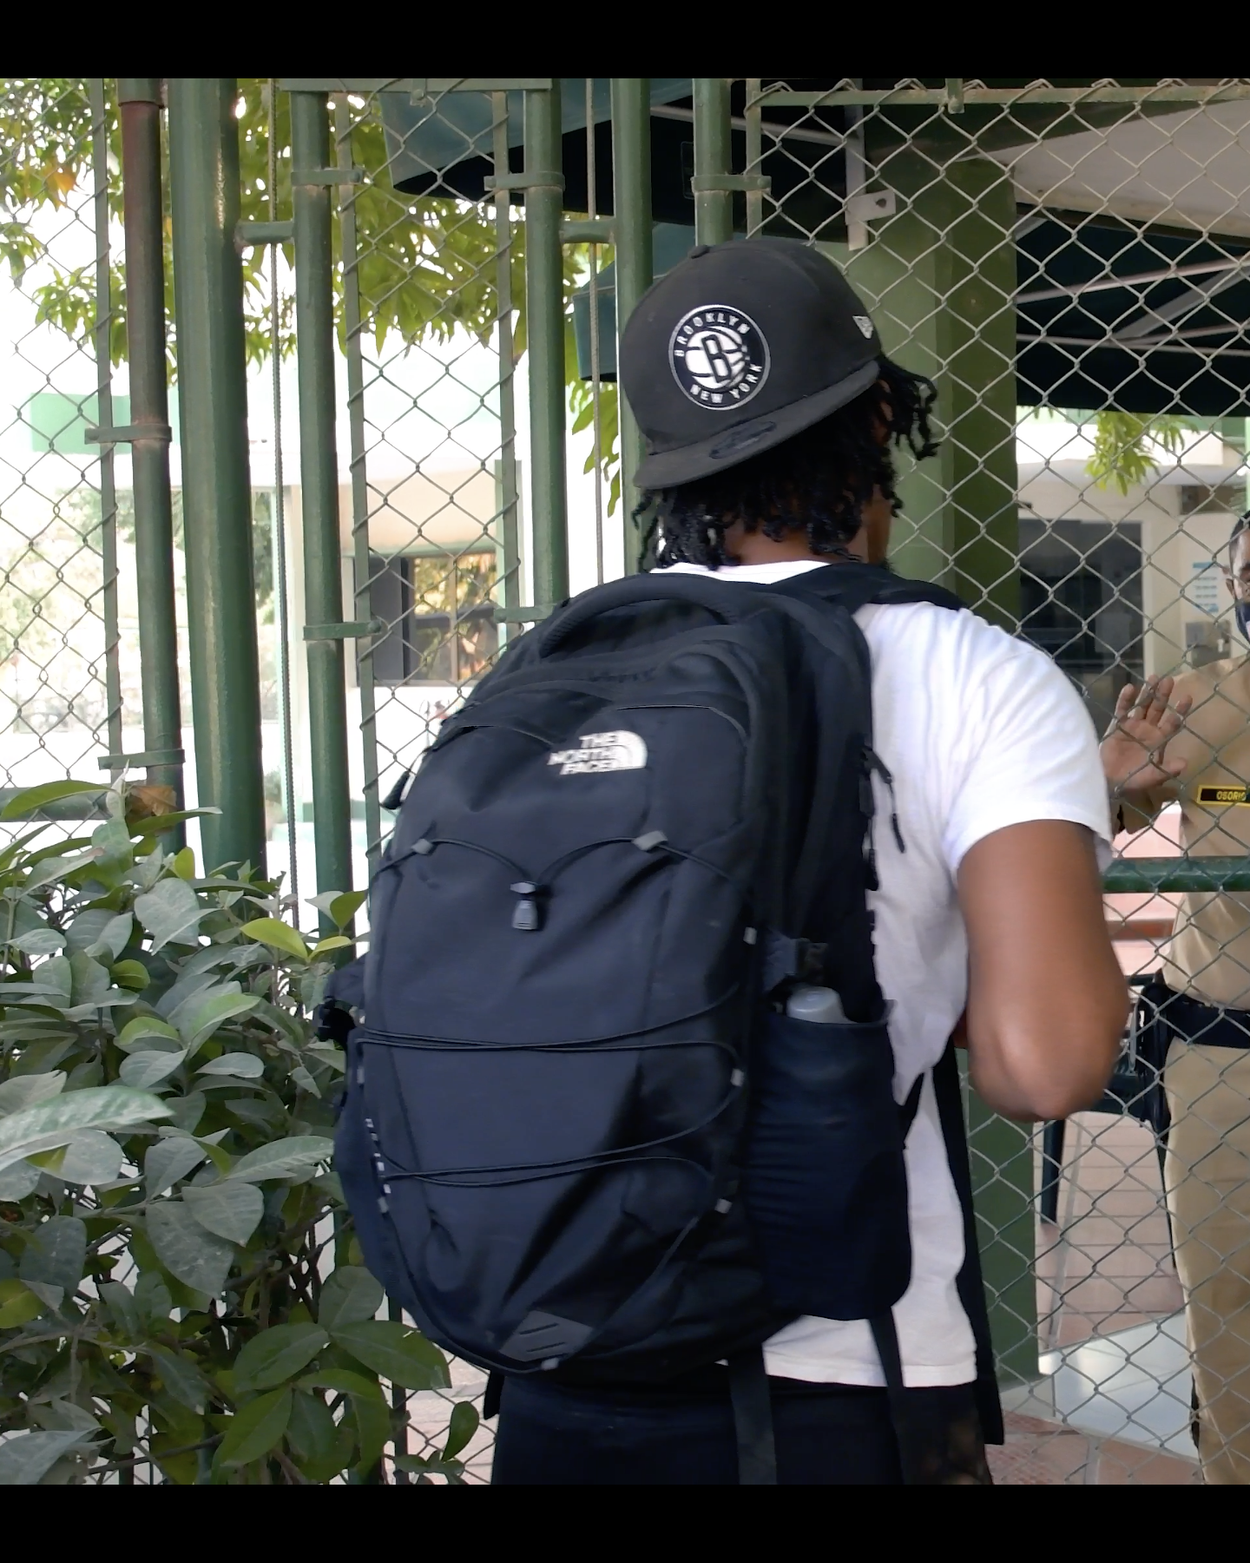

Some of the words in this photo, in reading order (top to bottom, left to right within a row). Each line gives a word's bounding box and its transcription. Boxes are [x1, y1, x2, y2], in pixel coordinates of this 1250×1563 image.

[674, 312, 751, 357] BROOKLYN
[690, 384, 723, 404] NEW
[729, 363, 762, 400] YORK
[579, 732, 619, 749] THE
[547, 747, 615, 766] NORTH
[559, 759, 616, 775] FACE
